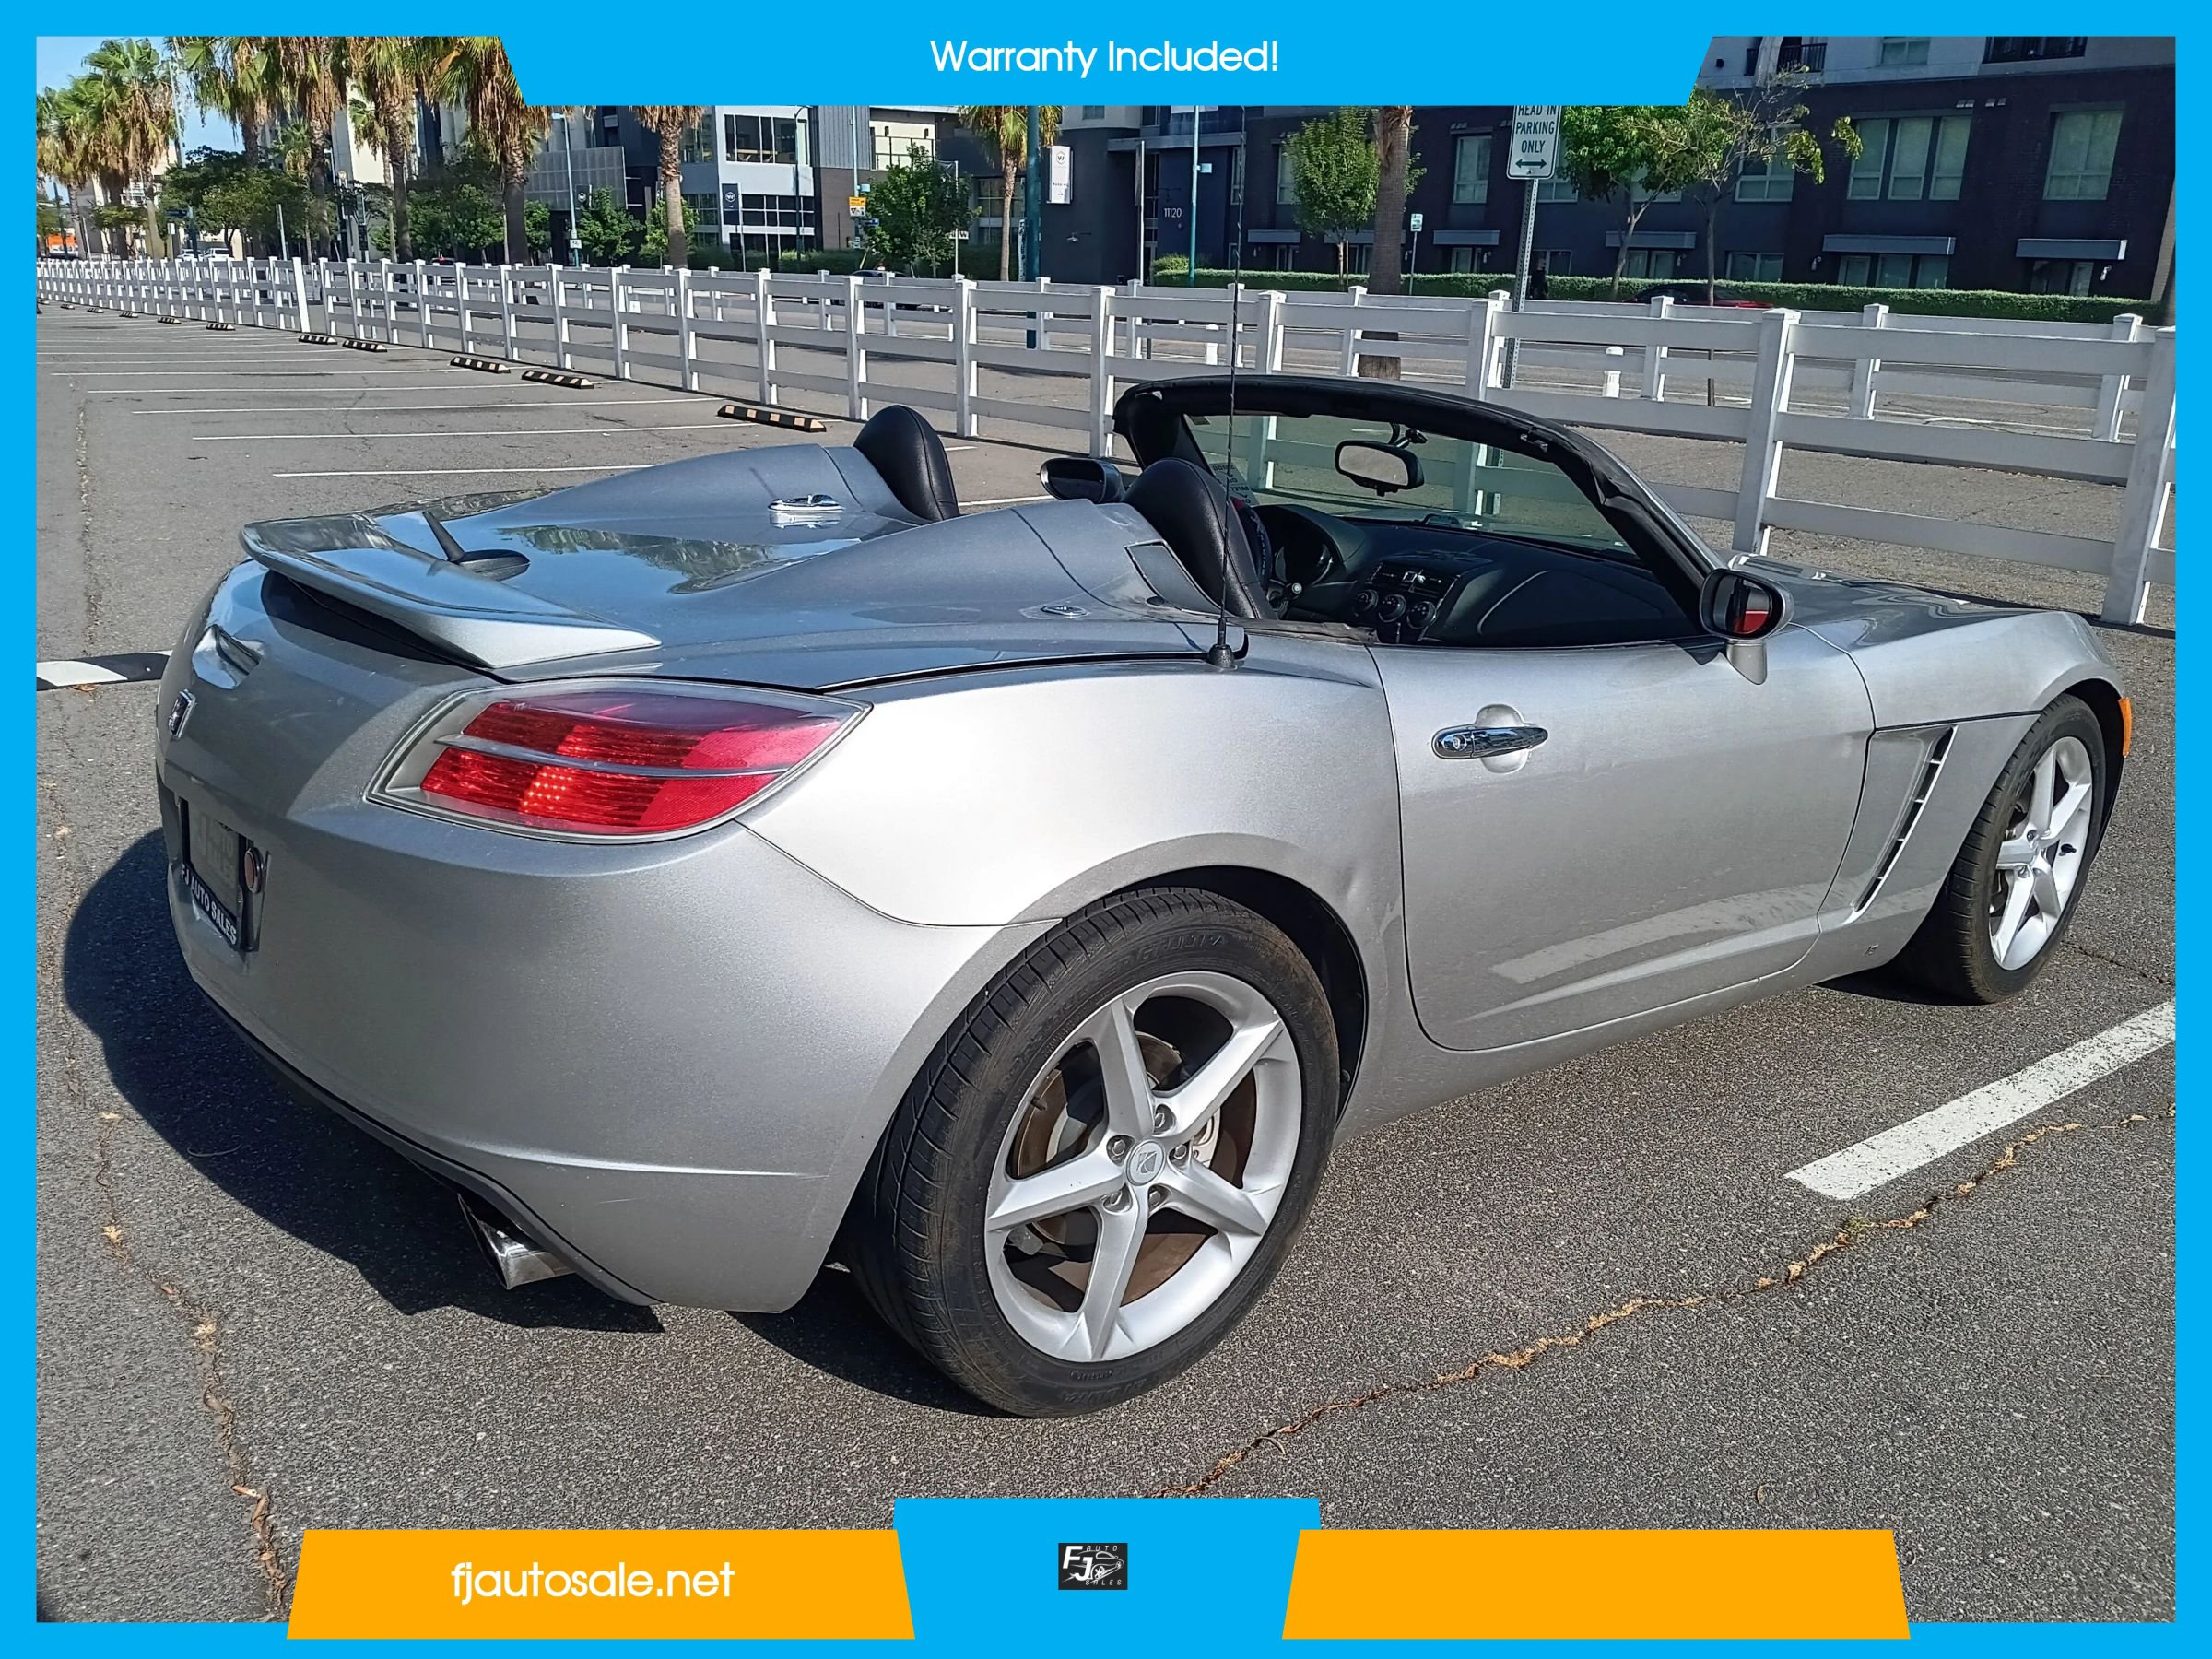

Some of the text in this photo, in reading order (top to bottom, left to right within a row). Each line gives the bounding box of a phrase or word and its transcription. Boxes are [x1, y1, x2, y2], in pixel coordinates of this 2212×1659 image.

[1517, 105, 1557, 115] HEAD IN
[1515, 121, 1555, 135] PARKING
[1521, 139, 1546, 153] ONLY
[1164, 207, 1182, 218] 11120
[181, 863, 190, 886] FJ
[191, 878, 210, 912] AUTO
[211, 903, 237, 945] SALES
